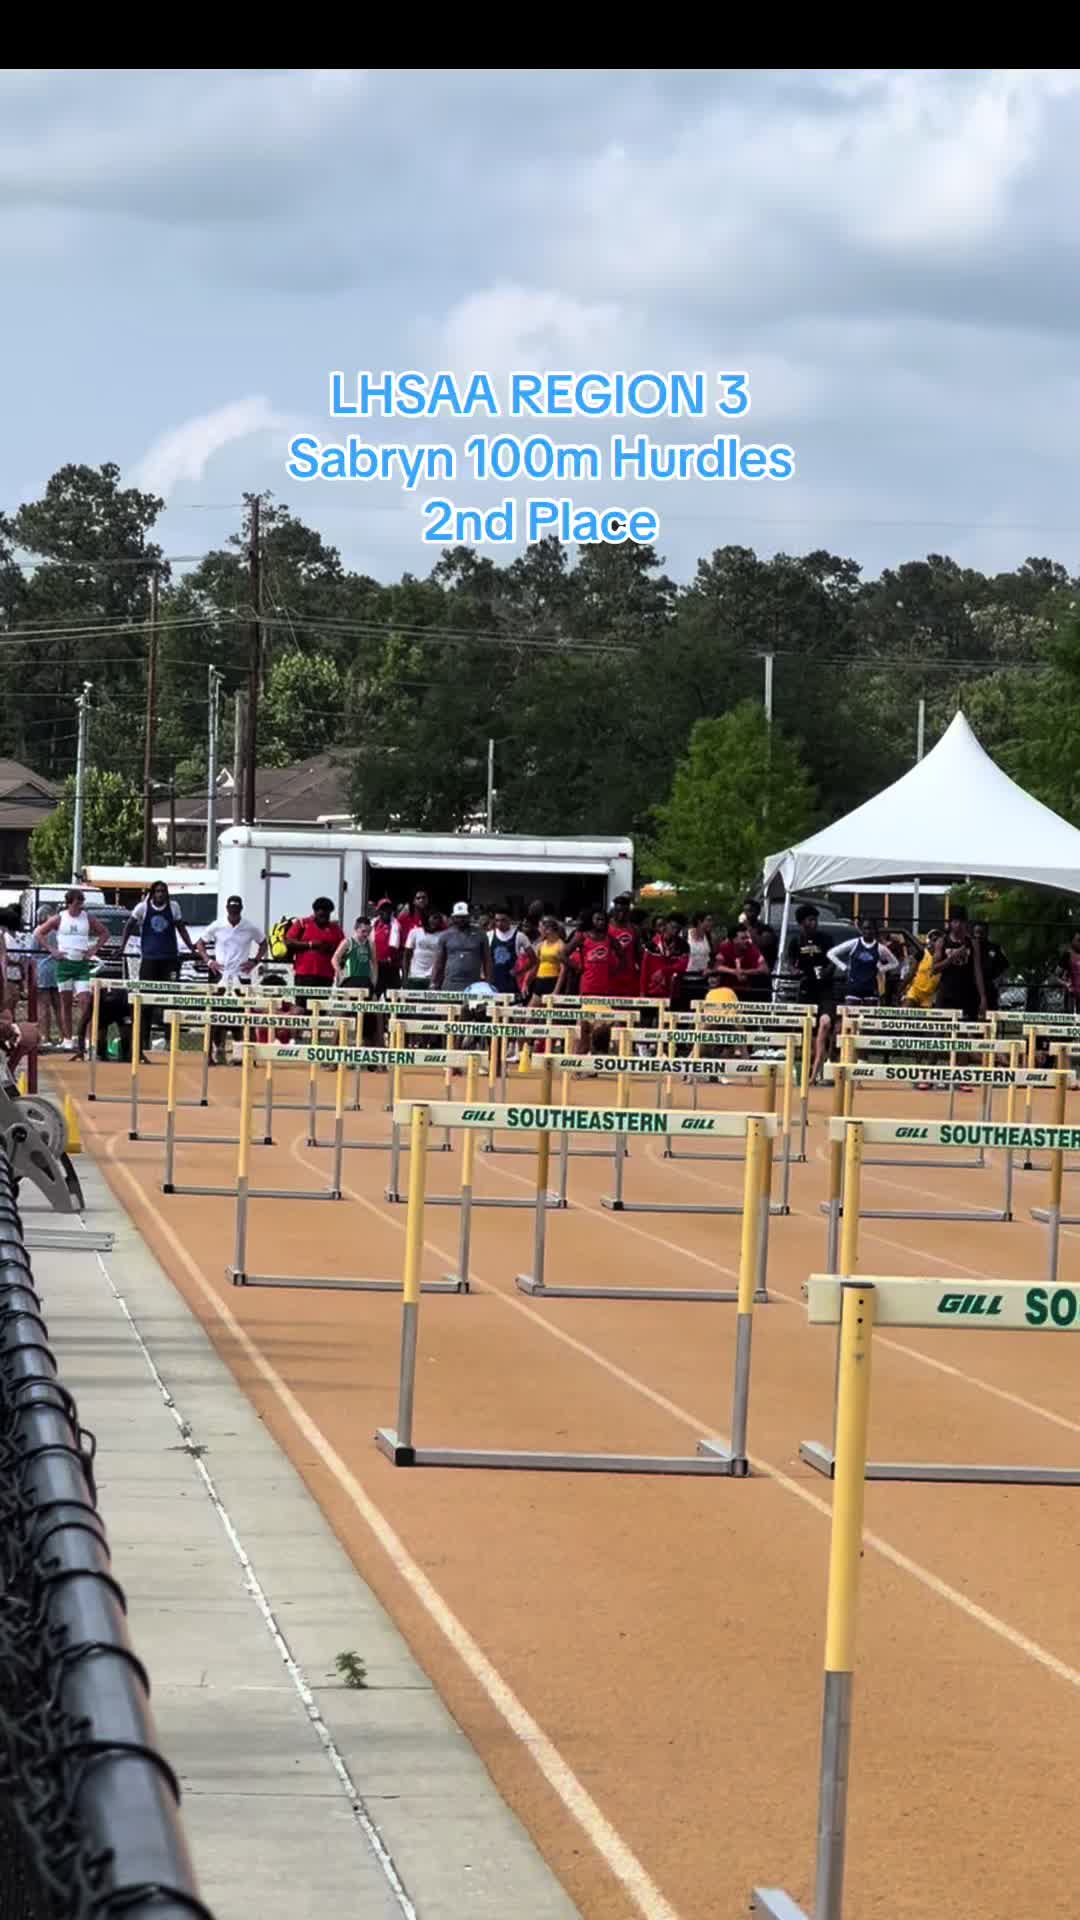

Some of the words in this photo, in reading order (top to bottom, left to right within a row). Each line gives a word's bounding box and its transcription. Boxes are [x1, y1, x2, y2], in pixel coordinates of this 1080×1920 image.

[210, 1014, 310, 1027] SOUTHEASTERN
[701, 1015, 780, 1025] SOUTHEASTERN
[881, 1021, 961, 1031] SOUTHEASTERN
[444, 1023, 526, 1036] SOUTHEASTERN
[667, 1031, 748, 1044] SOUTHEASTERN
[891, 1039, 973, 1051] SOUTHEASTERN
[307, 1047, 415, 1064] SOUTHEASTERN
[560, 1059, 583, 1068] GILL
[593, 1058, 726, 1074] SOUTHEASTERN
[736, 1064, 759, 1073] GILL
[885, 1067, 1016, 1083] SOUTHEASTERN
[461, 1109, 496, 1122] GILL
[507, 1107, 668, 1132] SOUTHEASTERN
[681, 1117, 716, 1130] GILL
[895, 1127, 929, 1139] GILL
[937, 1293, 1006, 1316] GILL
[1024, 1287, 1077, 1327] SO
